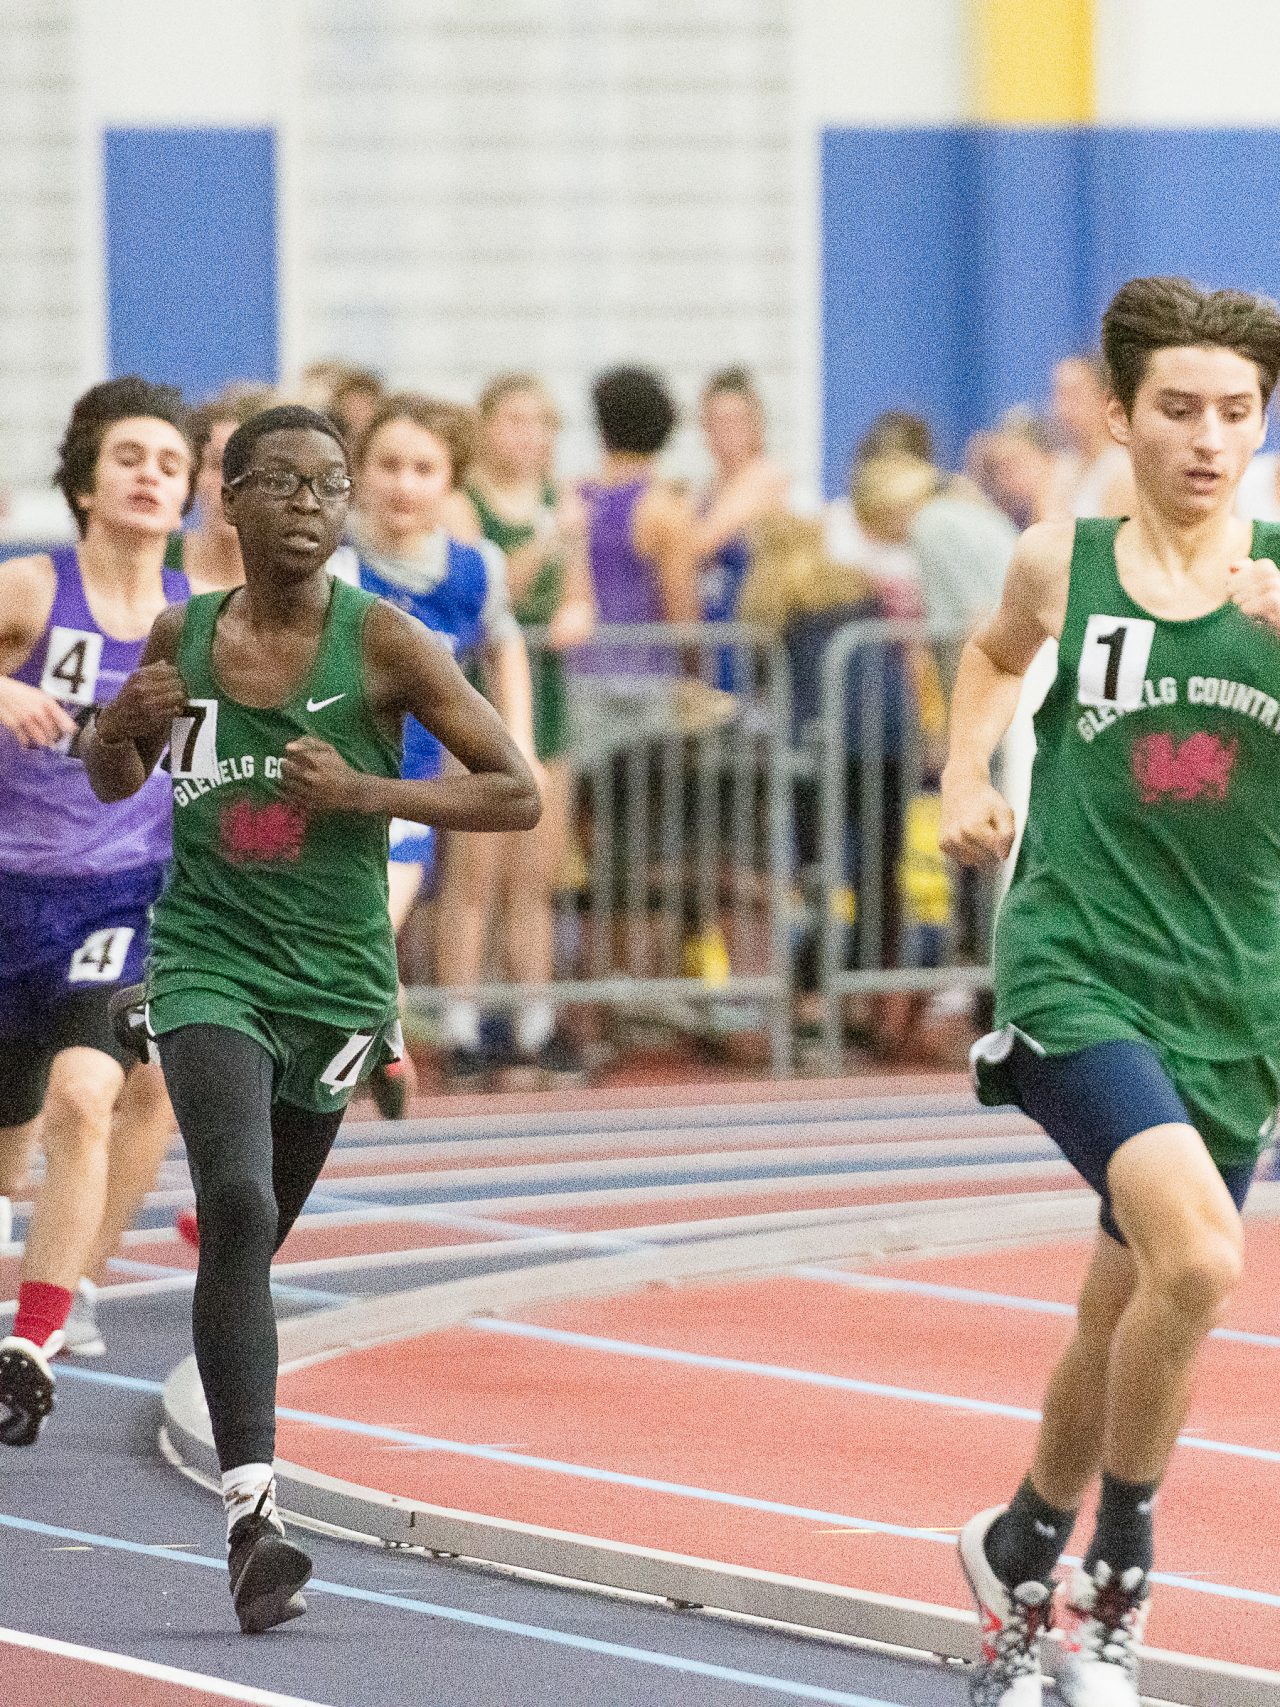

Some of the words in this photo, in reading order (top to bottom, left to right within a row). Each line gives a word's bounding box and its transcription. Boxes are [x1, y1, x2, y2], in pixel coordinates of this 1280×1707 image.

[52, 639, 87, 694] 4
[1097, 627, 1127, 701] 1
[179, 706, 207, 773] 7
[79, 934, 114, 973] 4
